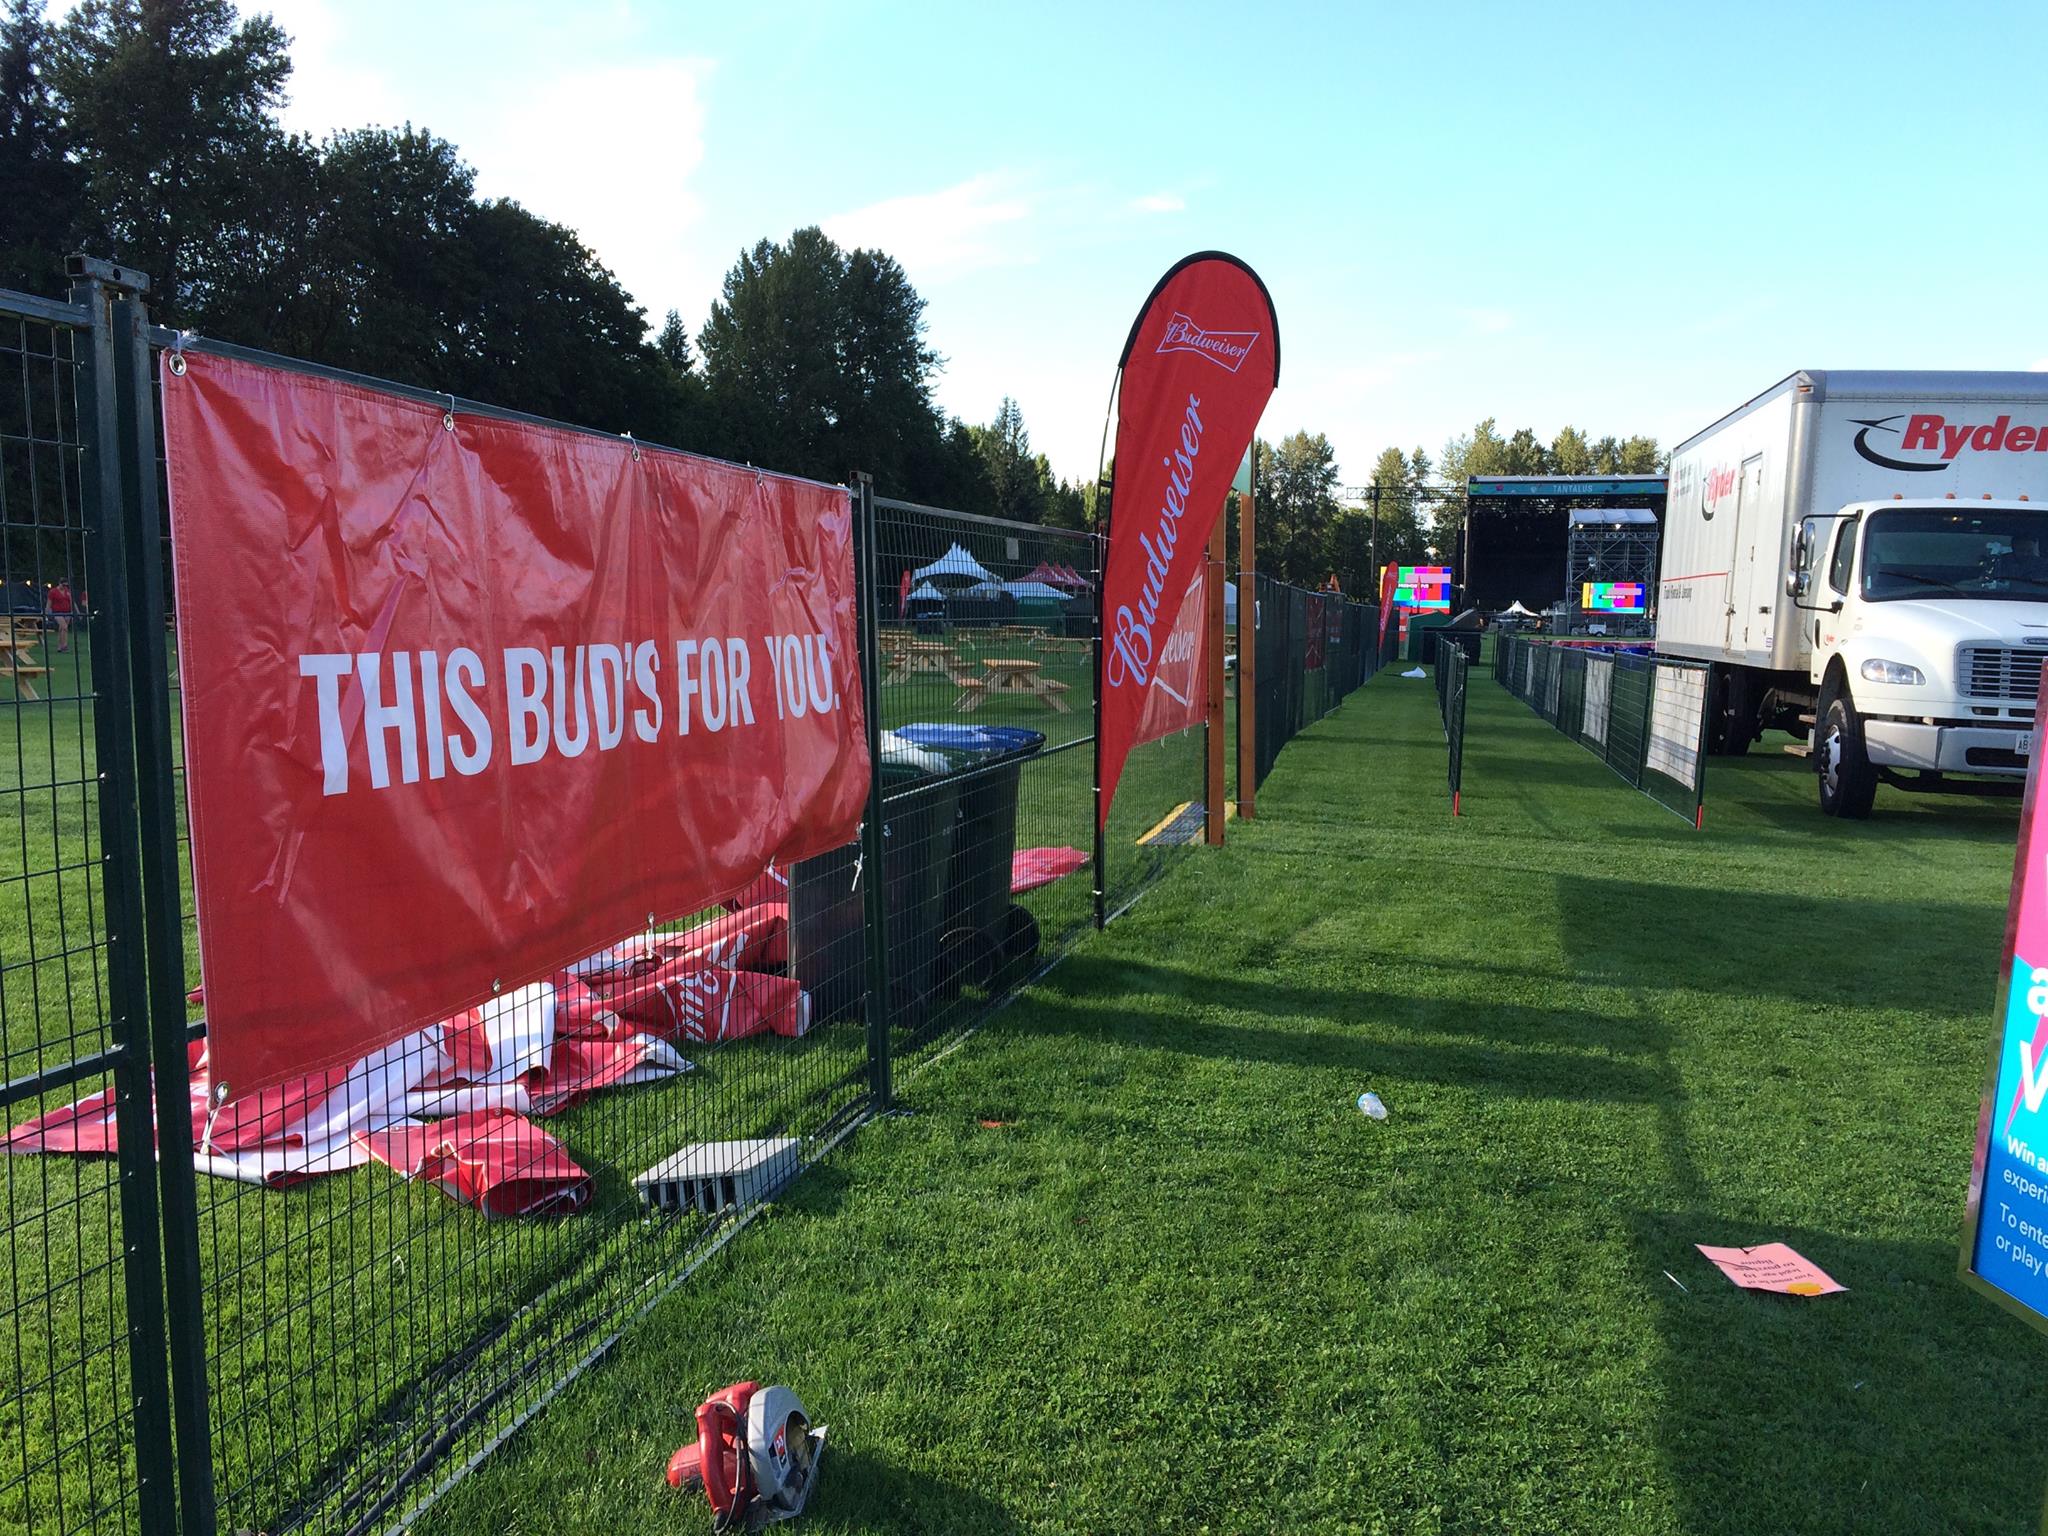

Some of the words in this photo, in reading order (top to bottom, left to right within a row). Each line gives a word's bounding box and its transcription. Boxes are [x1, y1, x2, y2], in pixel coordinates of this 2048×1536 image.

[1167, 322, 1247, 358] Budweiser
[1901, 414, 2048, 460] Ryder
[1552, 483, 1593, 494] TANTALUS
[1108, 393, 1203, 687] Budweiser
[299, 646, 493, 797] THIS
[505, 637, 662, 766] BUD'S
[677, 636, 756, 736] FOR
[764, 632, 843, 721] YOU.
[2007, 1134, 2035, 1168] Win
[2003, 1168, 2048, 1205] experi
[1999, 1202, 2017, 1229] To
[1996, 1234, 2010, 1253] or
[2012, 1245, 2043, 1276] play
